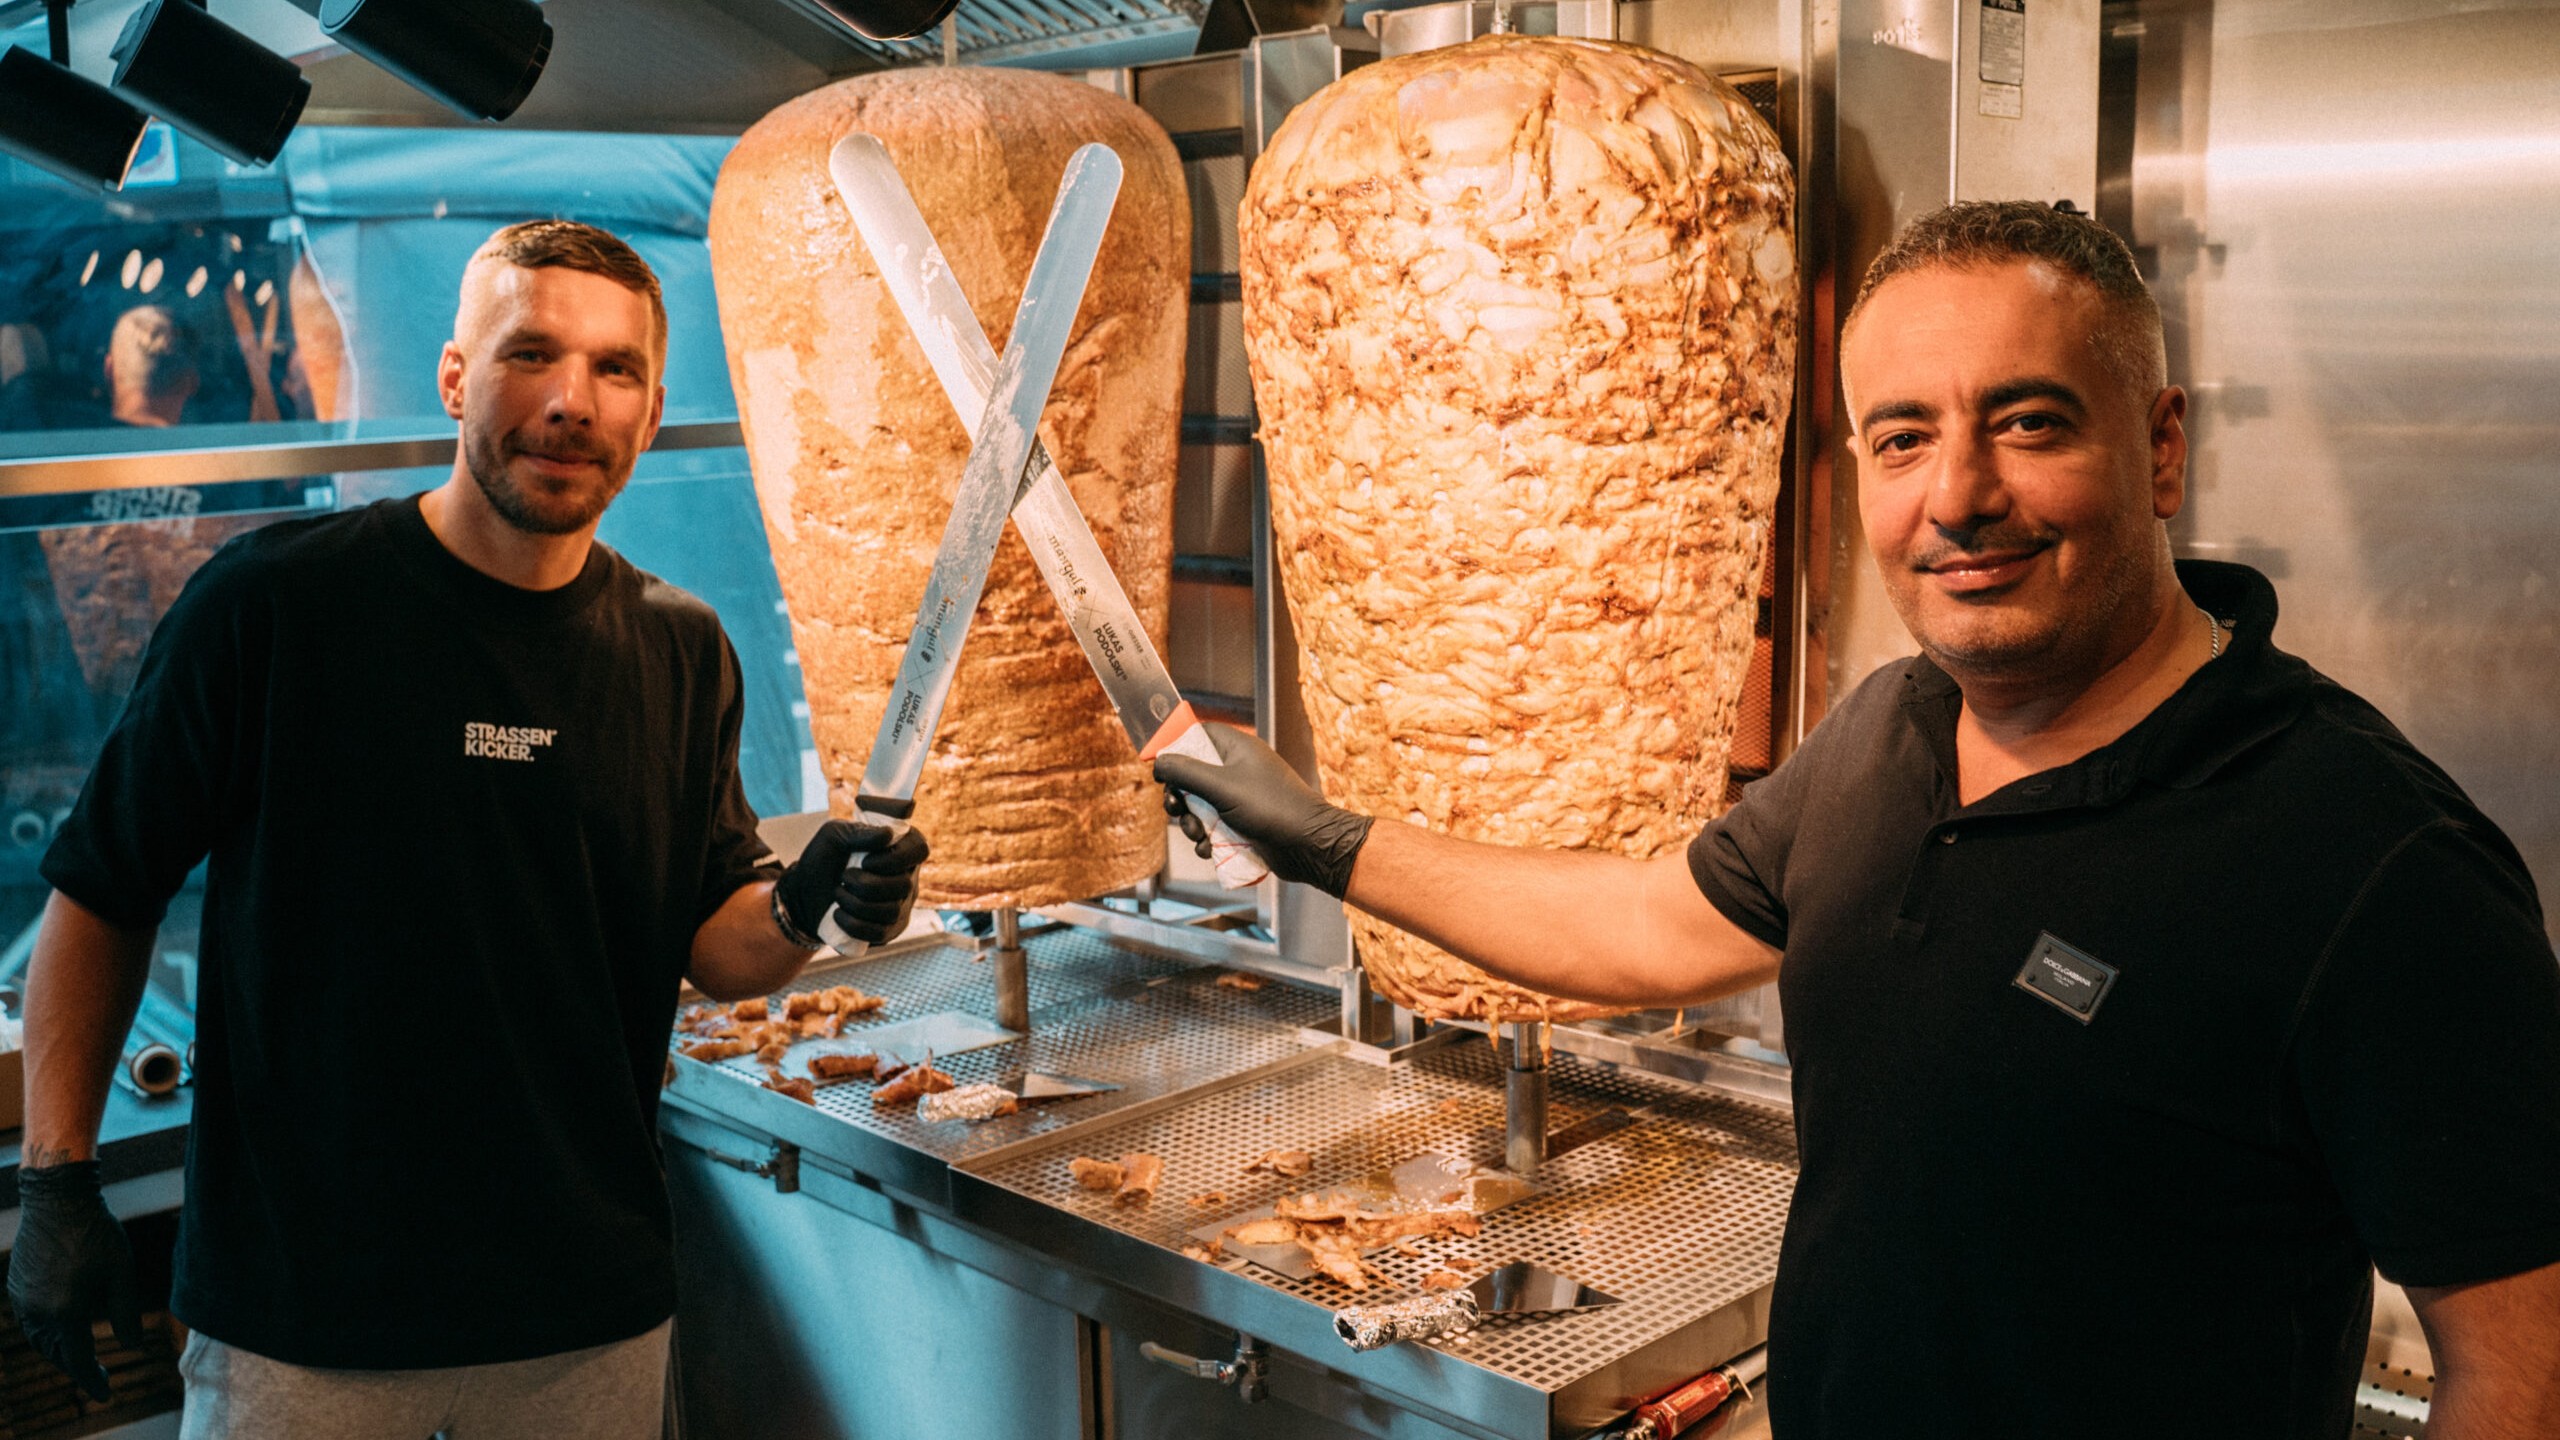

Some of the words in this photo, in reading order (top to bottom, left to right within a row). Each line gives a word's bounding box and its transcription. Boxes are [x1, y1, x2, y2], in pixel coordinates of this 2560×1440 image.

[1048, 535, 1083, 585] mangal
[1102, 622, 1124, 653] LUKAS
[906, 694, 922, 725] LUKAS
[464, 739, 535, 761] KICKER.
